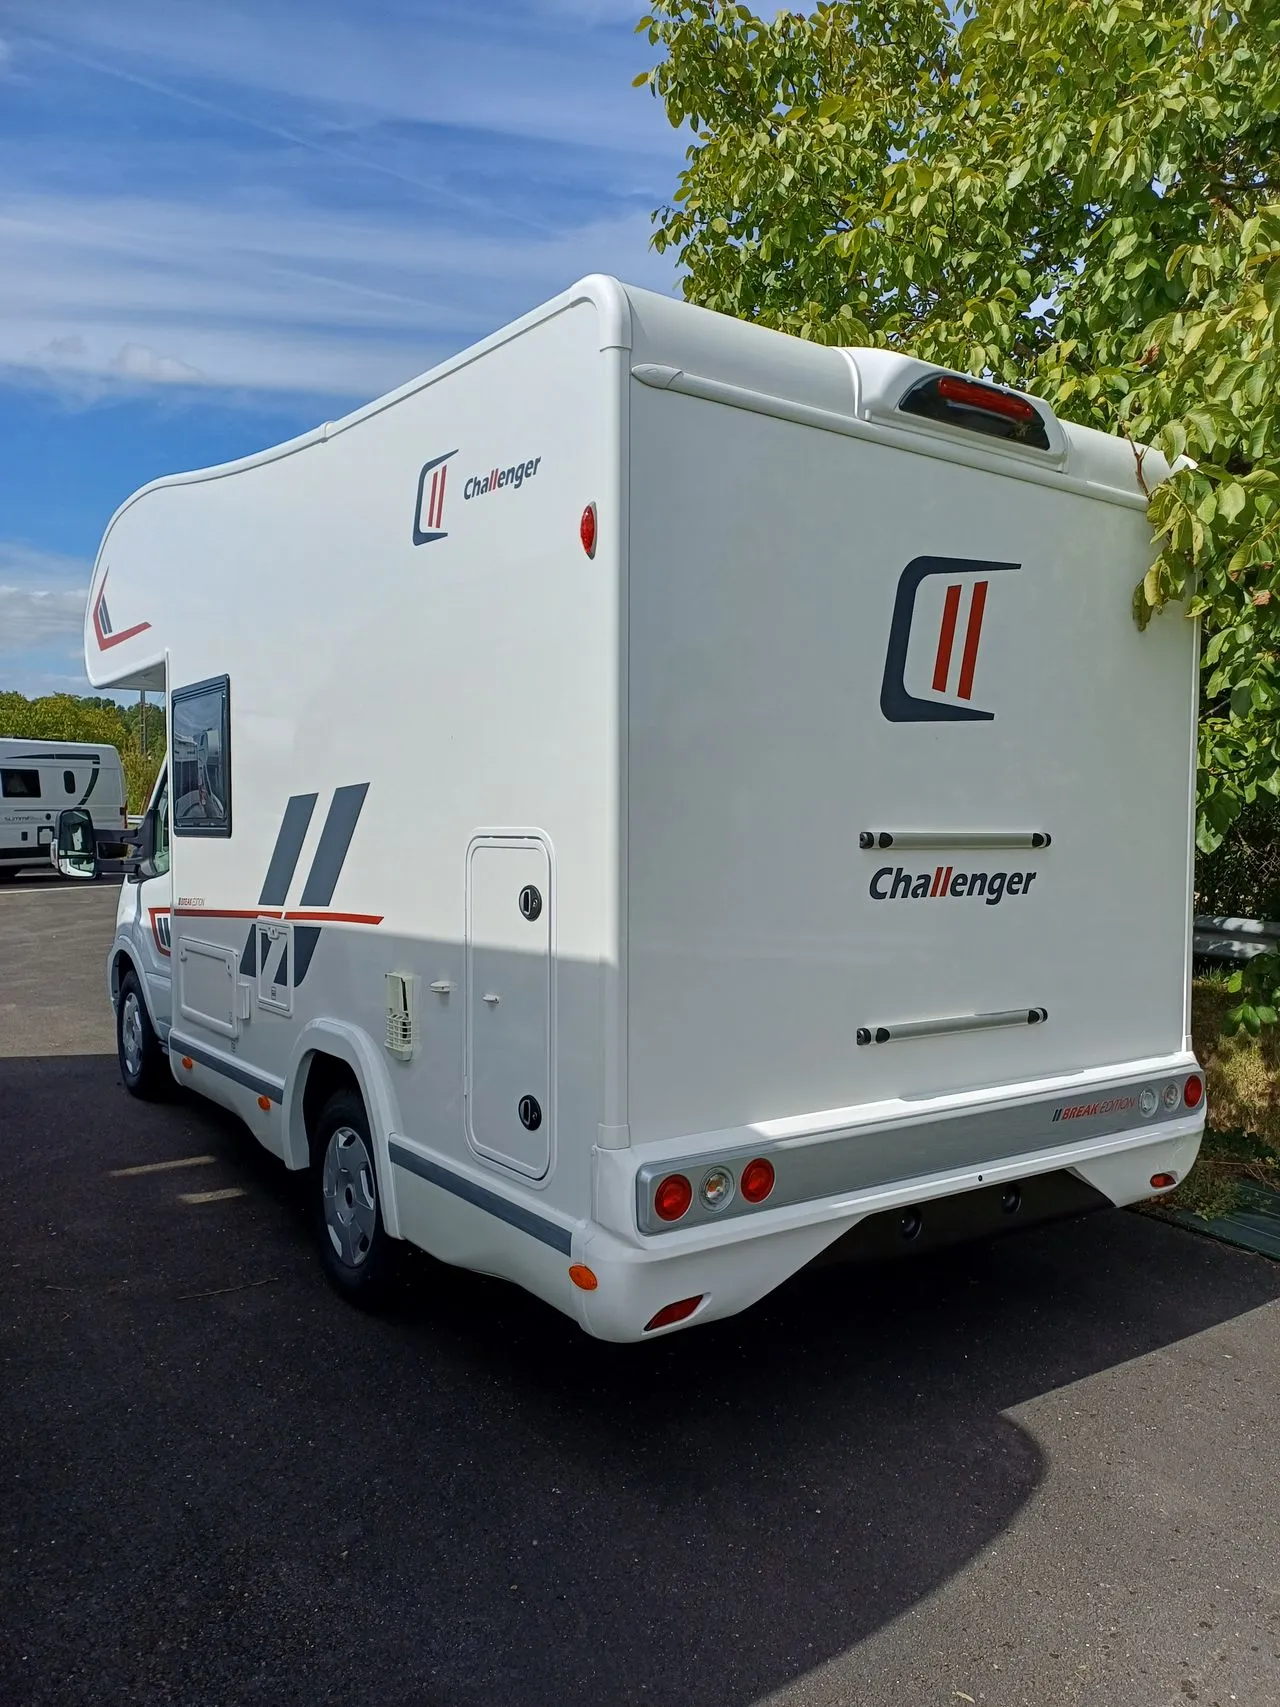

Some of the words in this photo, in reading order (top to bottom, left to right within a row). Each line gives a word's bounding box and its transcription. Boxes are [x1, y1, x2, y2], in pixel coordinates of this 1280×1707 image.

[464, 456, 541, 500] Challenger
[869, 866, 1037, 905] Challenger
[1063, 1104, 1099, 1120] BREAK
[1100, 1097, 1136, 1114] EDITION
